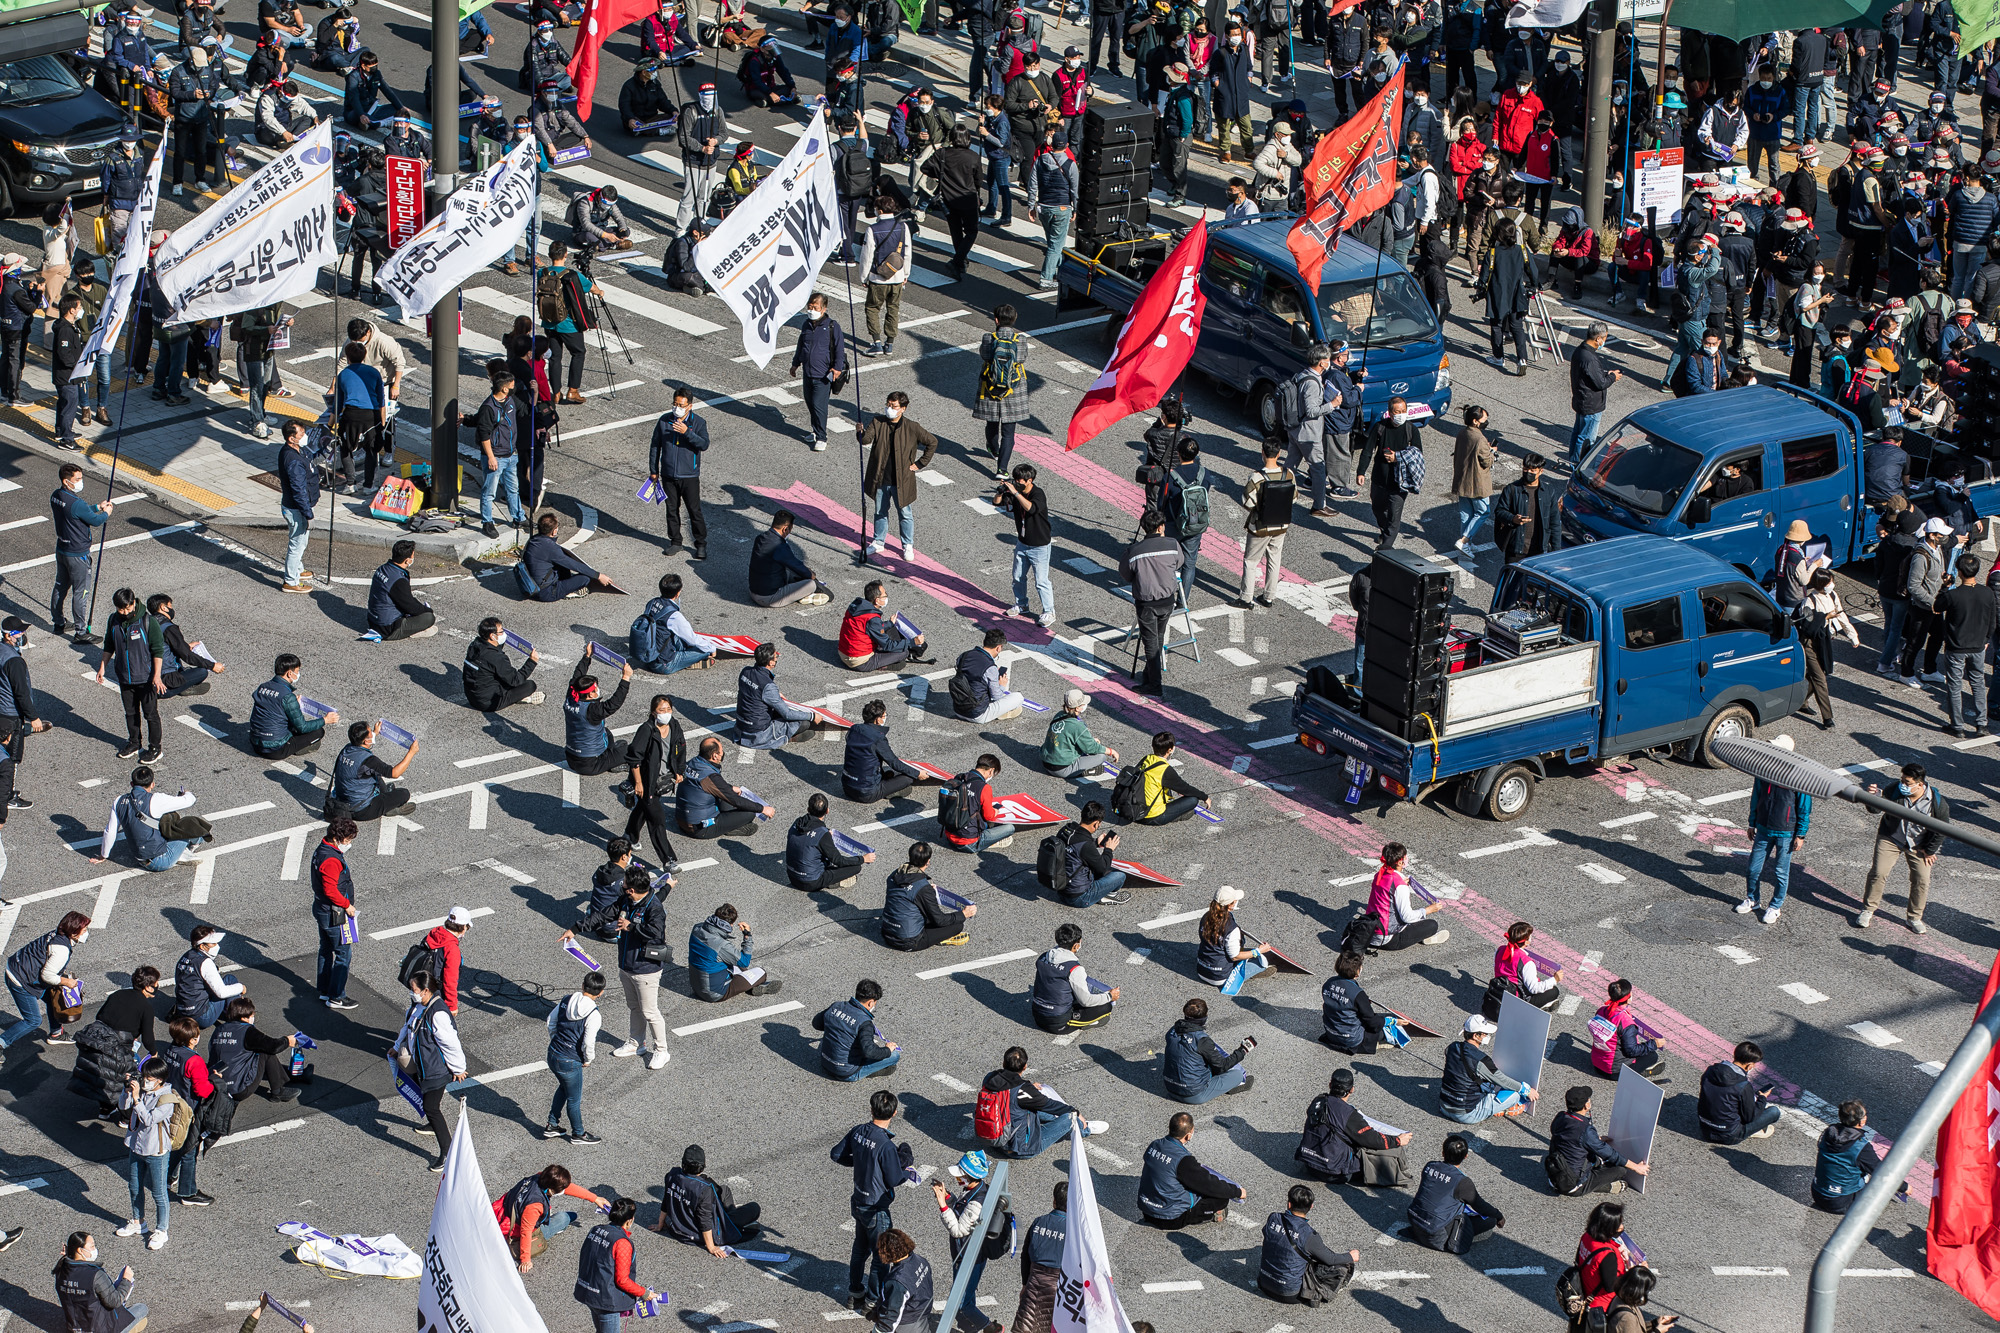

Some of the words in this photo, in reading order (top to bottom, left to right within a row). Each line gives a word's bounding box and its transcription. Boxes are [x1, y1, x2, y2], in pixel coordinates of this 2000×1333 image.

[375, 492, 407, 511] WELCOME
[1332, 727, 1369, 752] HYUNDAI
[830, 1007, 858, 1026] 코웨이지부
[1147, 1147, 1173, 1166] 코웨이지부
[1423, 1166, 1452, 1185] 코웨이지부
[1033, 1224, 1065, 1242] 코웨이지부
